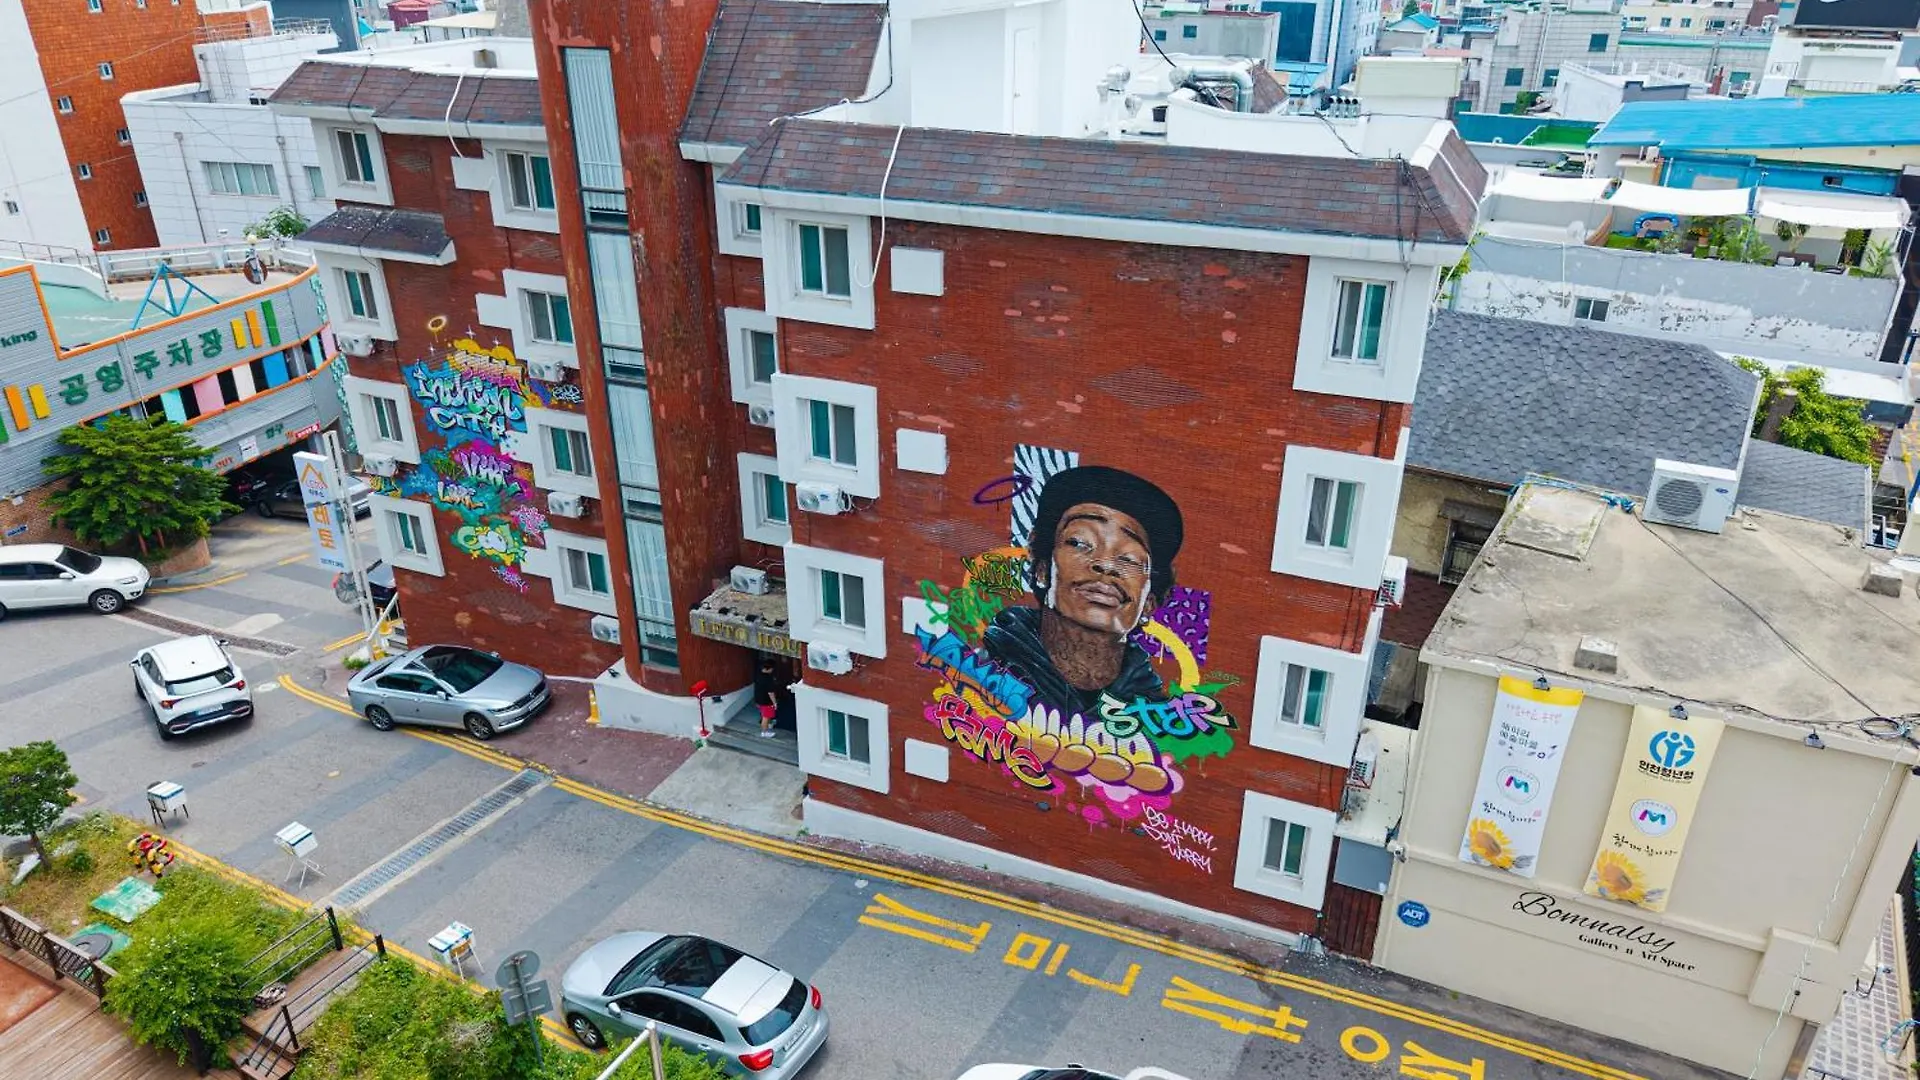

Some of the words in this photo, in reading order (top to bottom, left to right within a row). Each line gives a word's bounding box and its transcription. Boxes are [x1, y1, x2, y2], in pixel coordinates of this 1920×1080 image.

[59, 327, 223, 406] 공영주차장
[1403, 909, 1425, 920] ADT
[1512, 890, 1676, 953] Bomnalsy
[1578, 934, 1619, 951] Gallery
[1641, 950, 1657, 962] Art
[1660, 955, 1696, 972] Space
